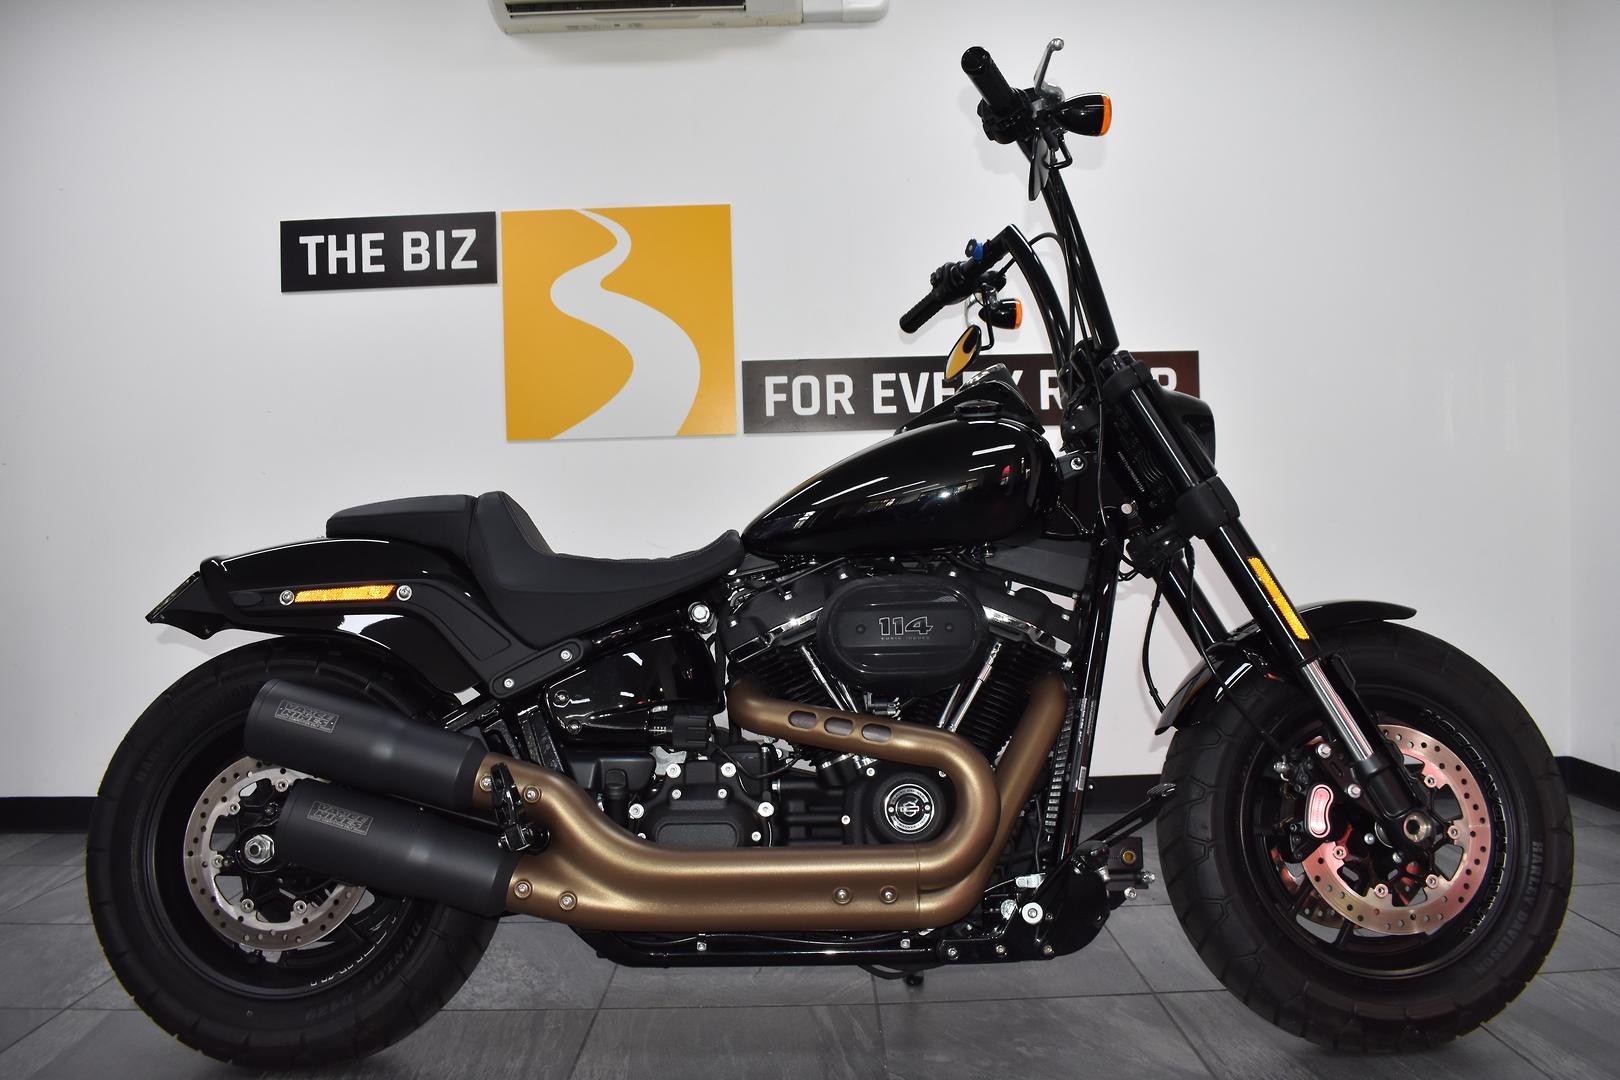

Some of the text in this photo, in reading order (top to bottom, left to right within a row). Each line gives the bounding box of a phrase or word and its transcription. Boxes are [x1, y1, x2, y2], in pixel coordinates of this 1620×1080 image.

[299, 228, 478, 276] THE BIZ
[764, 373, 856, 418] FOR
[878, 616, 934, 636] 114
